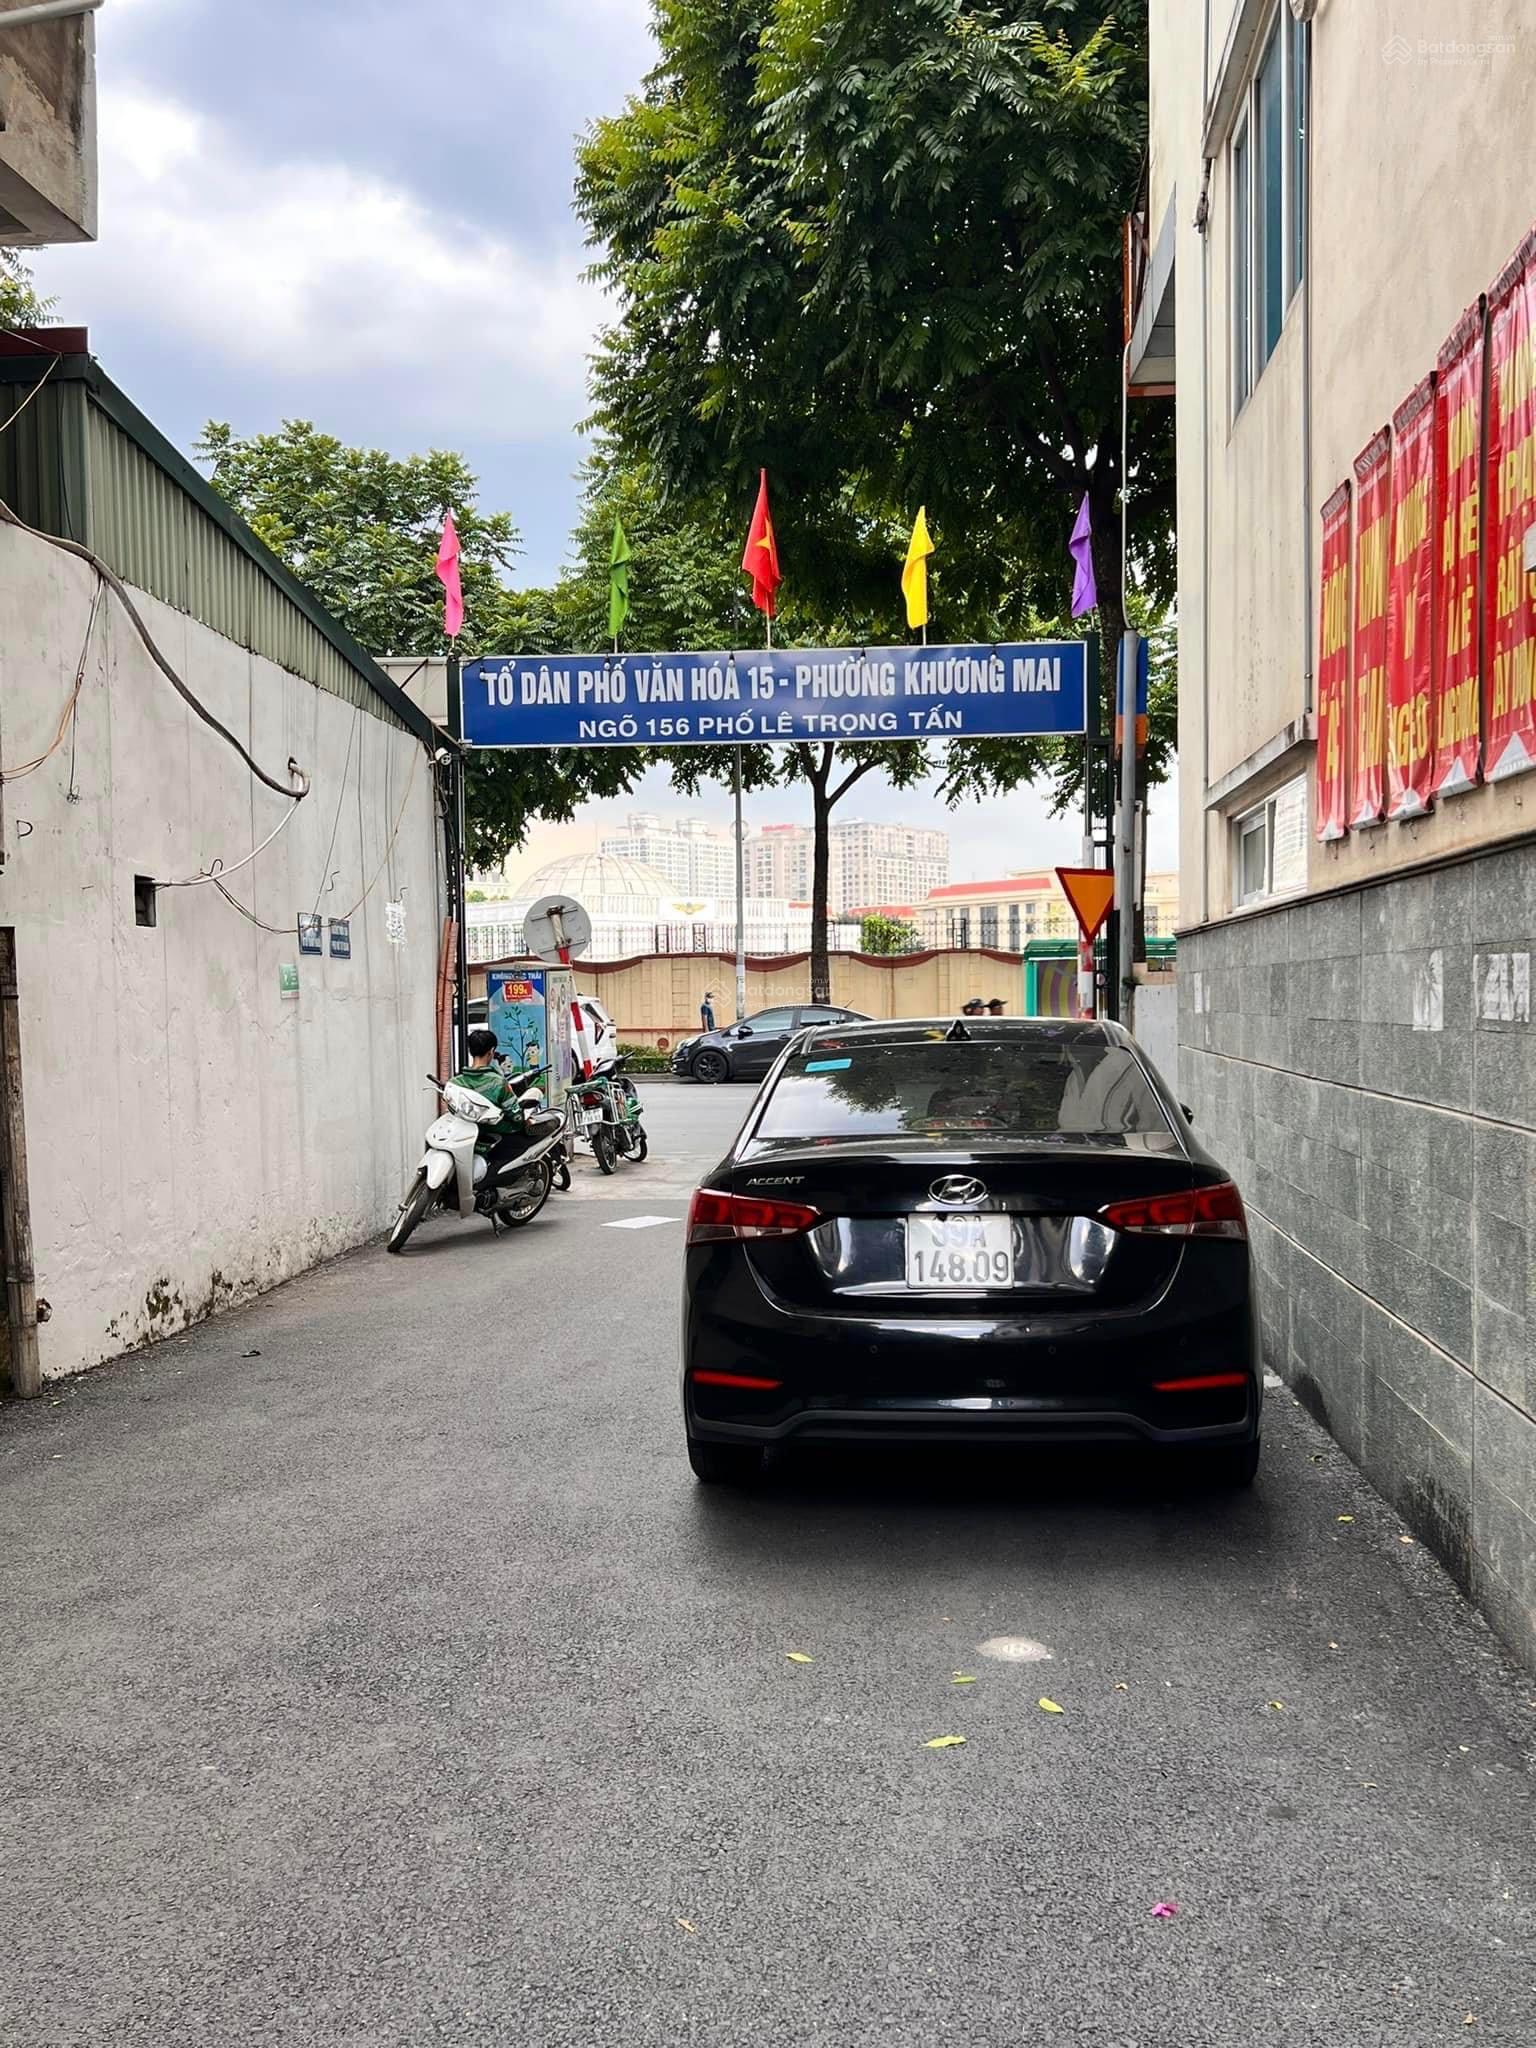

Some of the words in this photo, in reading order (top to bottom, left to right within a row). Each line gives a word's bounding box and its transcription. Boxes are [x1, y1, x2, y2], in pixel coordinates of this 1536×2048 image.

[484, 660, 516, 706] TỔ
[521, 665, 571, 705] DÂN
[578, 658, 627, 704] PHỐ
[634, 662, 684, 703] VĂN
[747, 666, 775, 700] 15
[796, 655, 896, 698] PHƯỜNG
[904, 656, 1006, 696] KHƯƠNG
[1013, 657, 1061, 693] MAI
[579, 714, 638, 738] NGÕ
[646, 718, 690, 736] 156
[698, 709, 755, 735] PHỐ
[761, 712, 793, 734] LÊ
[803, 712, 897, 735] TRỌNG
[908, 703, 962, 730] TẤN
[746, 1176, 805, 1186] ACCENT
[914, 1250, 1010, 1283] 148.09
